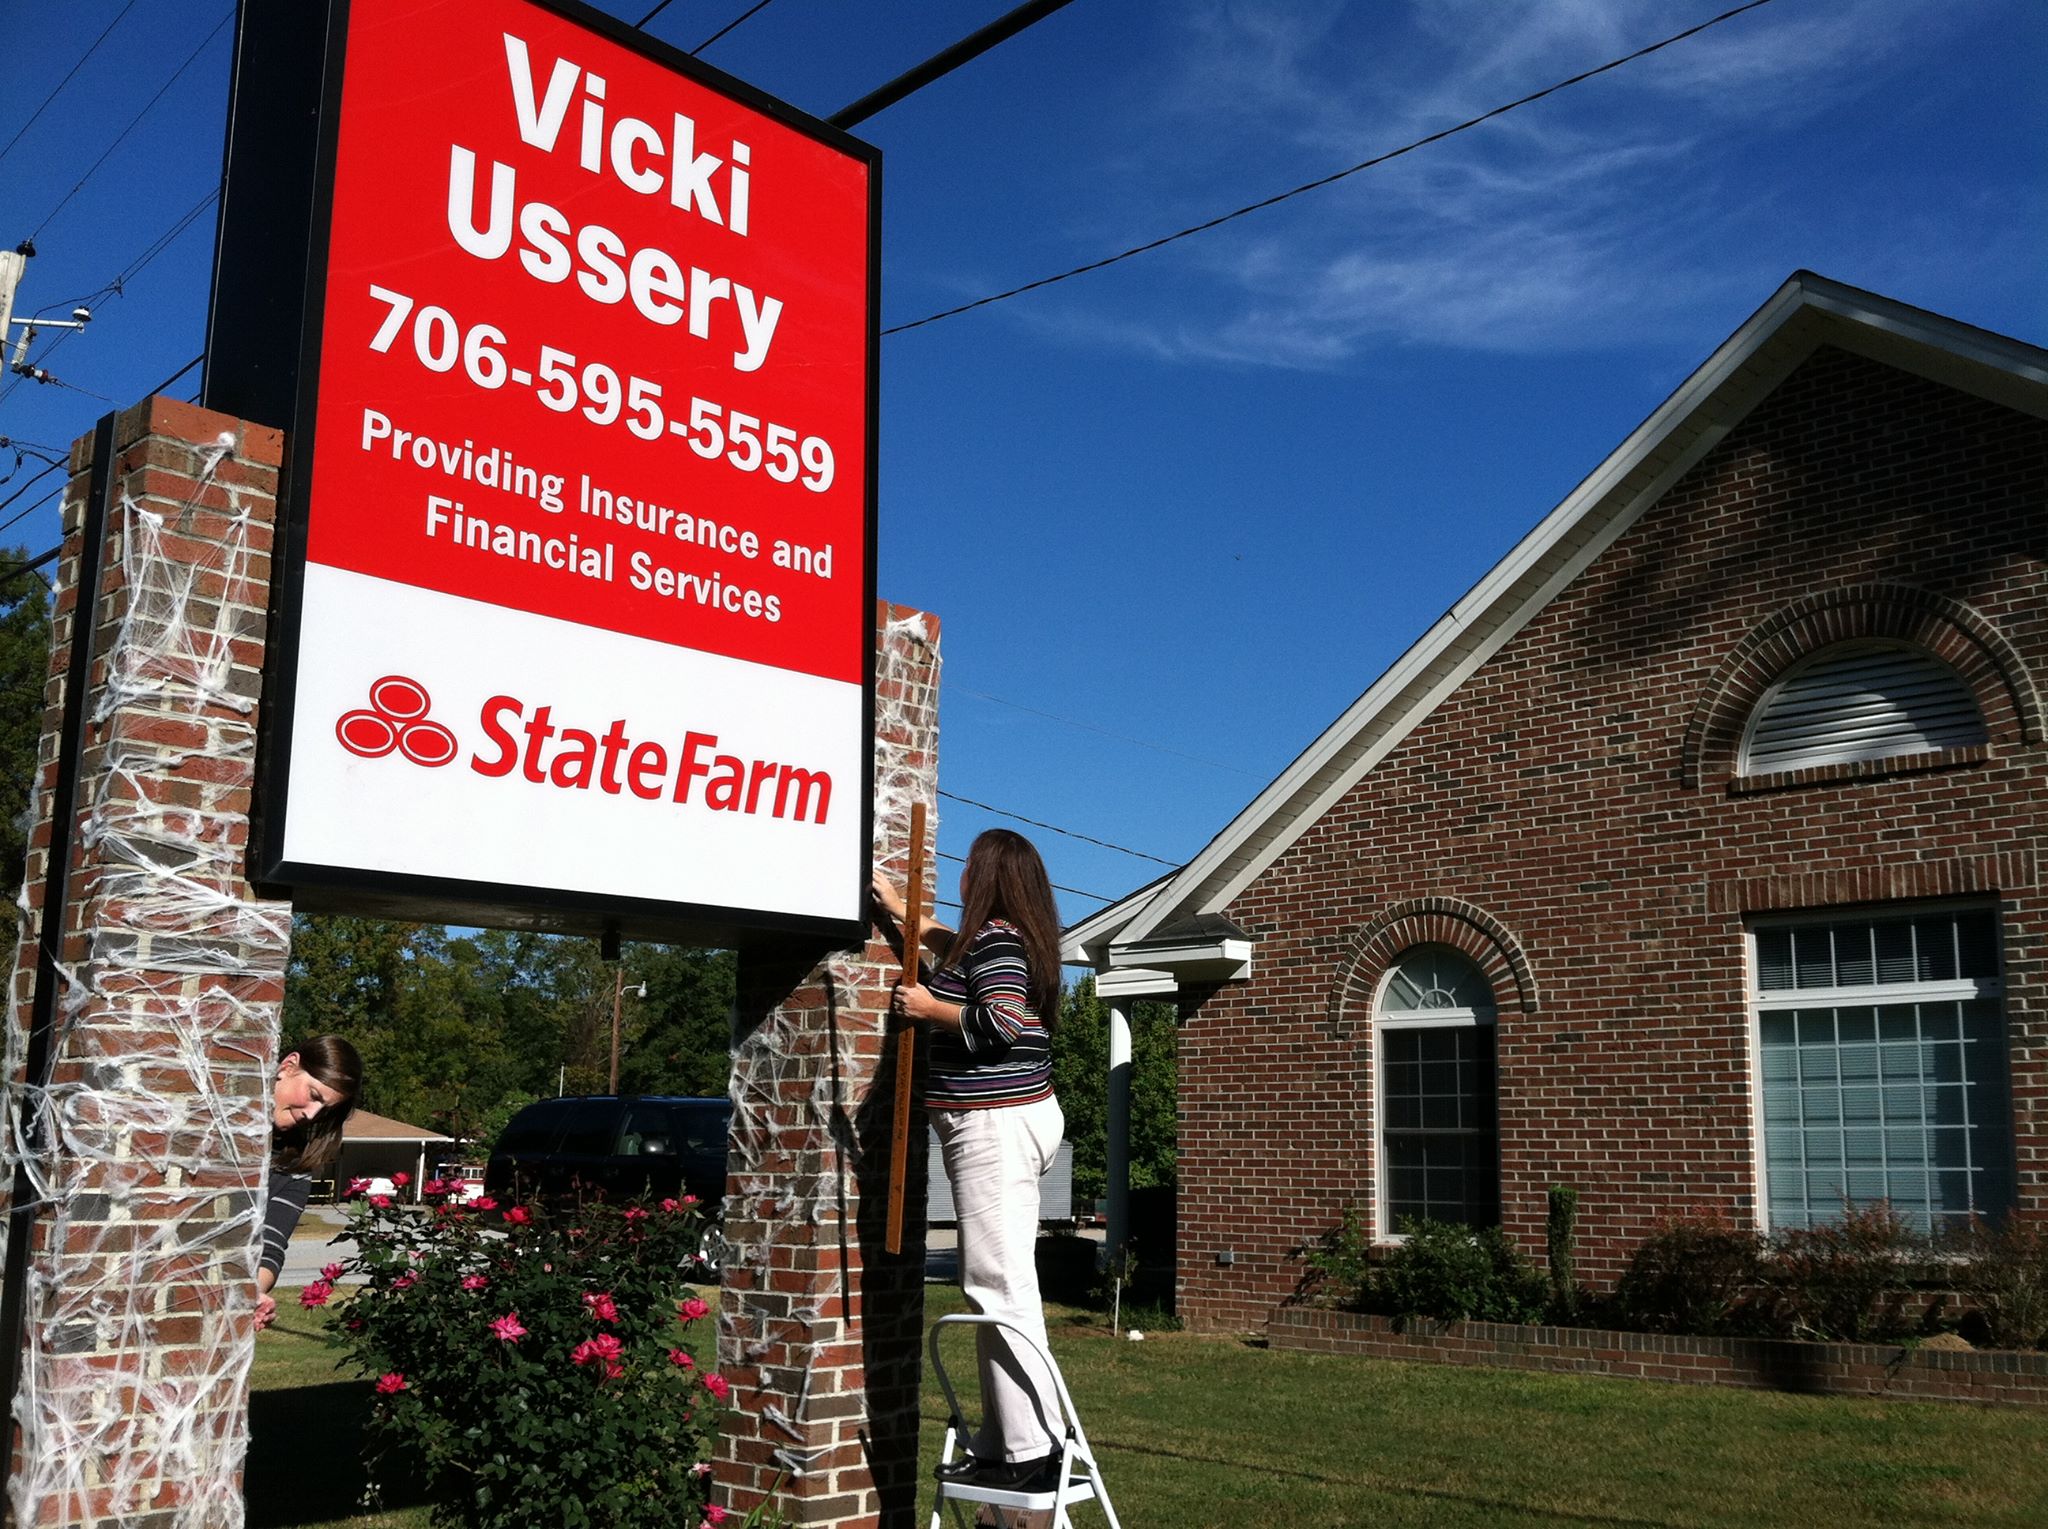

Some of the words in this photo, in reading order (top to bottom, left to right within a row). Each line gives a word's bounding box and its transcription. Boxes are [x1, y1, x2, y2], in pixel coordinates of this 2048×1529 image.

[502, 31, 752, 238] Vicki
[446, 142, 785, 373] Ussery
[368, 283, 836, 494] 706-595-5559
[361, 407, 566, 514] Providing
[579, 473, 760, 560] Insurance
[771, 539, 833, 580] and
[425, 494, 615, 583] Financial
[628, 550, 782, 623] Services
